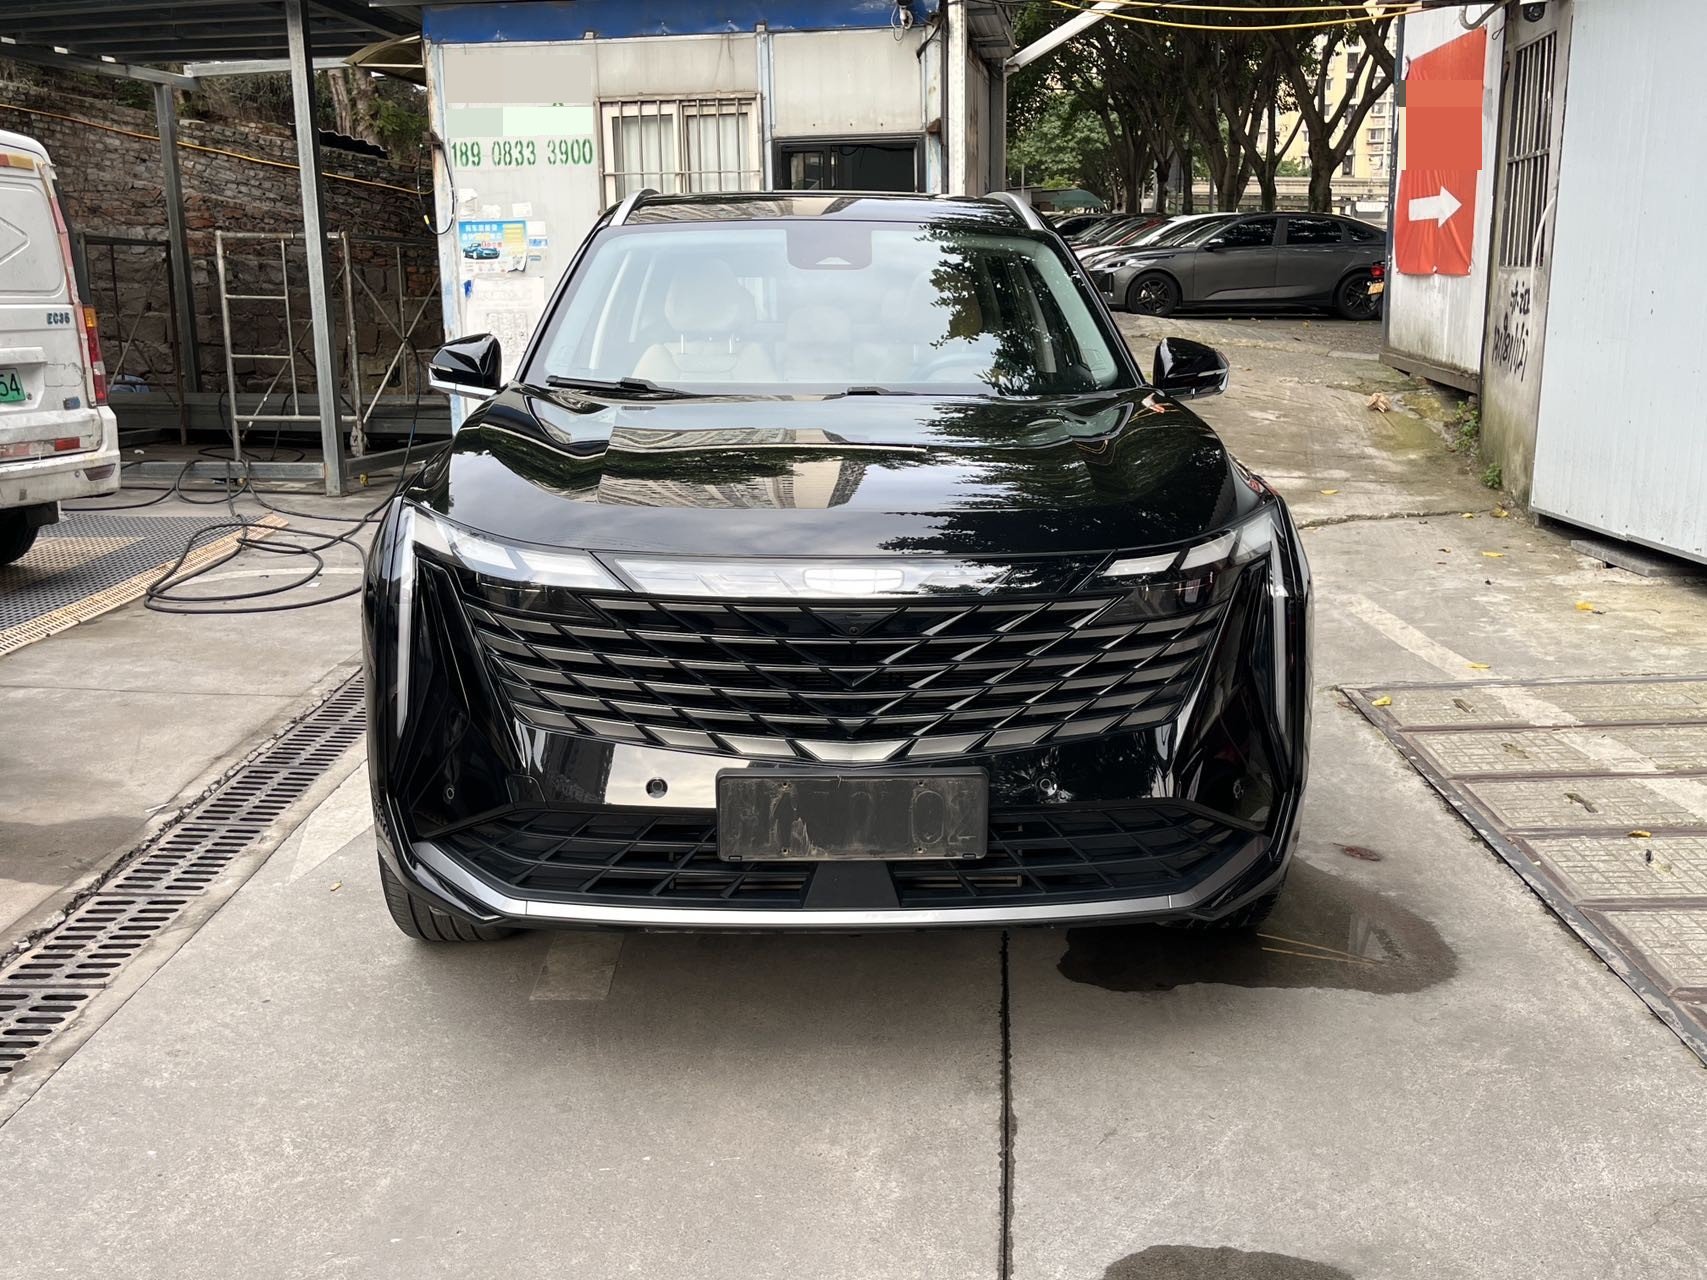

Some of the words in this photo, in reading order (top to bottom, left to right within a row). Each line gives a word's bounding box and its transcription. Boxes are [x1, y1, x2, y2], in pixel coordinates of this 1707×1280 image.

[451, 141, 481, 167] 189
[491, 140, 536, 166] 0833
[547, 138, 593, 165] 3900
